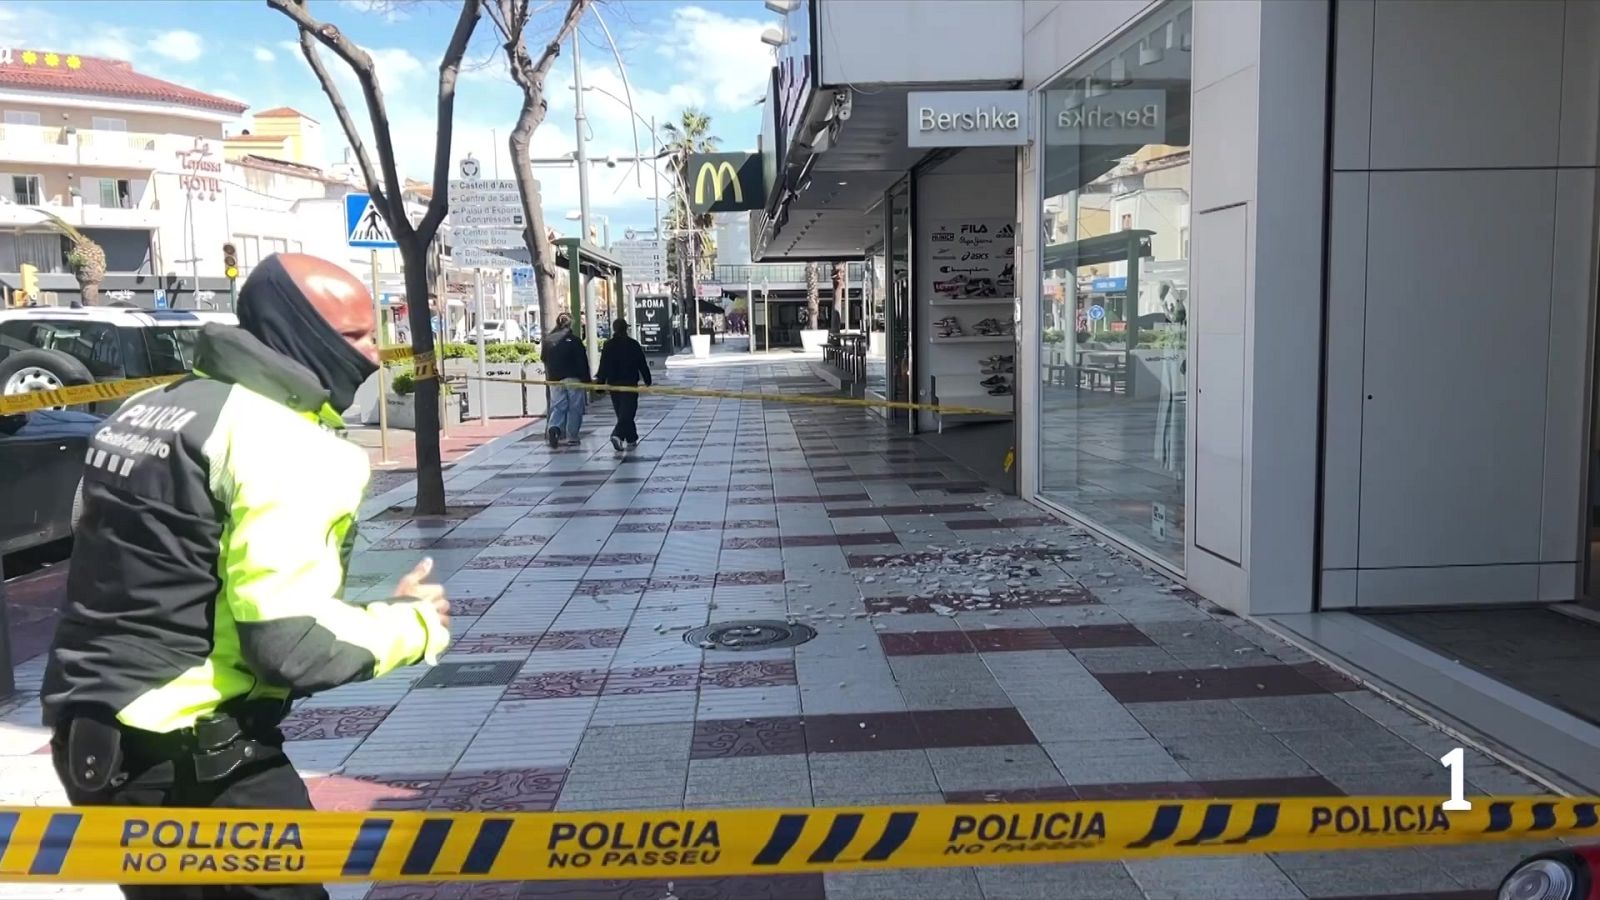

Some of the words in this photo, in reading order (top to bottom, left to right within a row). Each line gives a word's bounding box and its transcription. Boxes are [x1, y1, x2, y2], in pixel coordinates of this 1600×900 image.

[919, 106, 1020, 133] Bershka
[179, 175, 222, 193] HOTEL
[460, 181, 488, 189] Castell
[491, 180, 513, 189] d'Aro
[460, 194, 486, 202] Centre
[487, 194, 498, 202] de
[500, 194, 519, 202] Salut
[461, 207, 483, 215] Palau
[484, 206, 521, 215] d'Esports
[465, 215, 511, 225] Congressos
[960, 224, 989, 234] FILA
[462, 228, 488, 236] Centre
[116, 404, 198, 432] POLICIA
[948, 812, 1106, 842] POLICIA
[1309, 804, 1451, 834] POLICIA
[120, 819, 304, 850] POLICIA
[547, 820, 721, 851] POLICIA
[122, 853, 168, 873] NO
[179, 854, 305, 873] PASSEU
[547, 852, 592, 868] NO
[601, 850, 721, 867] PASSEU
